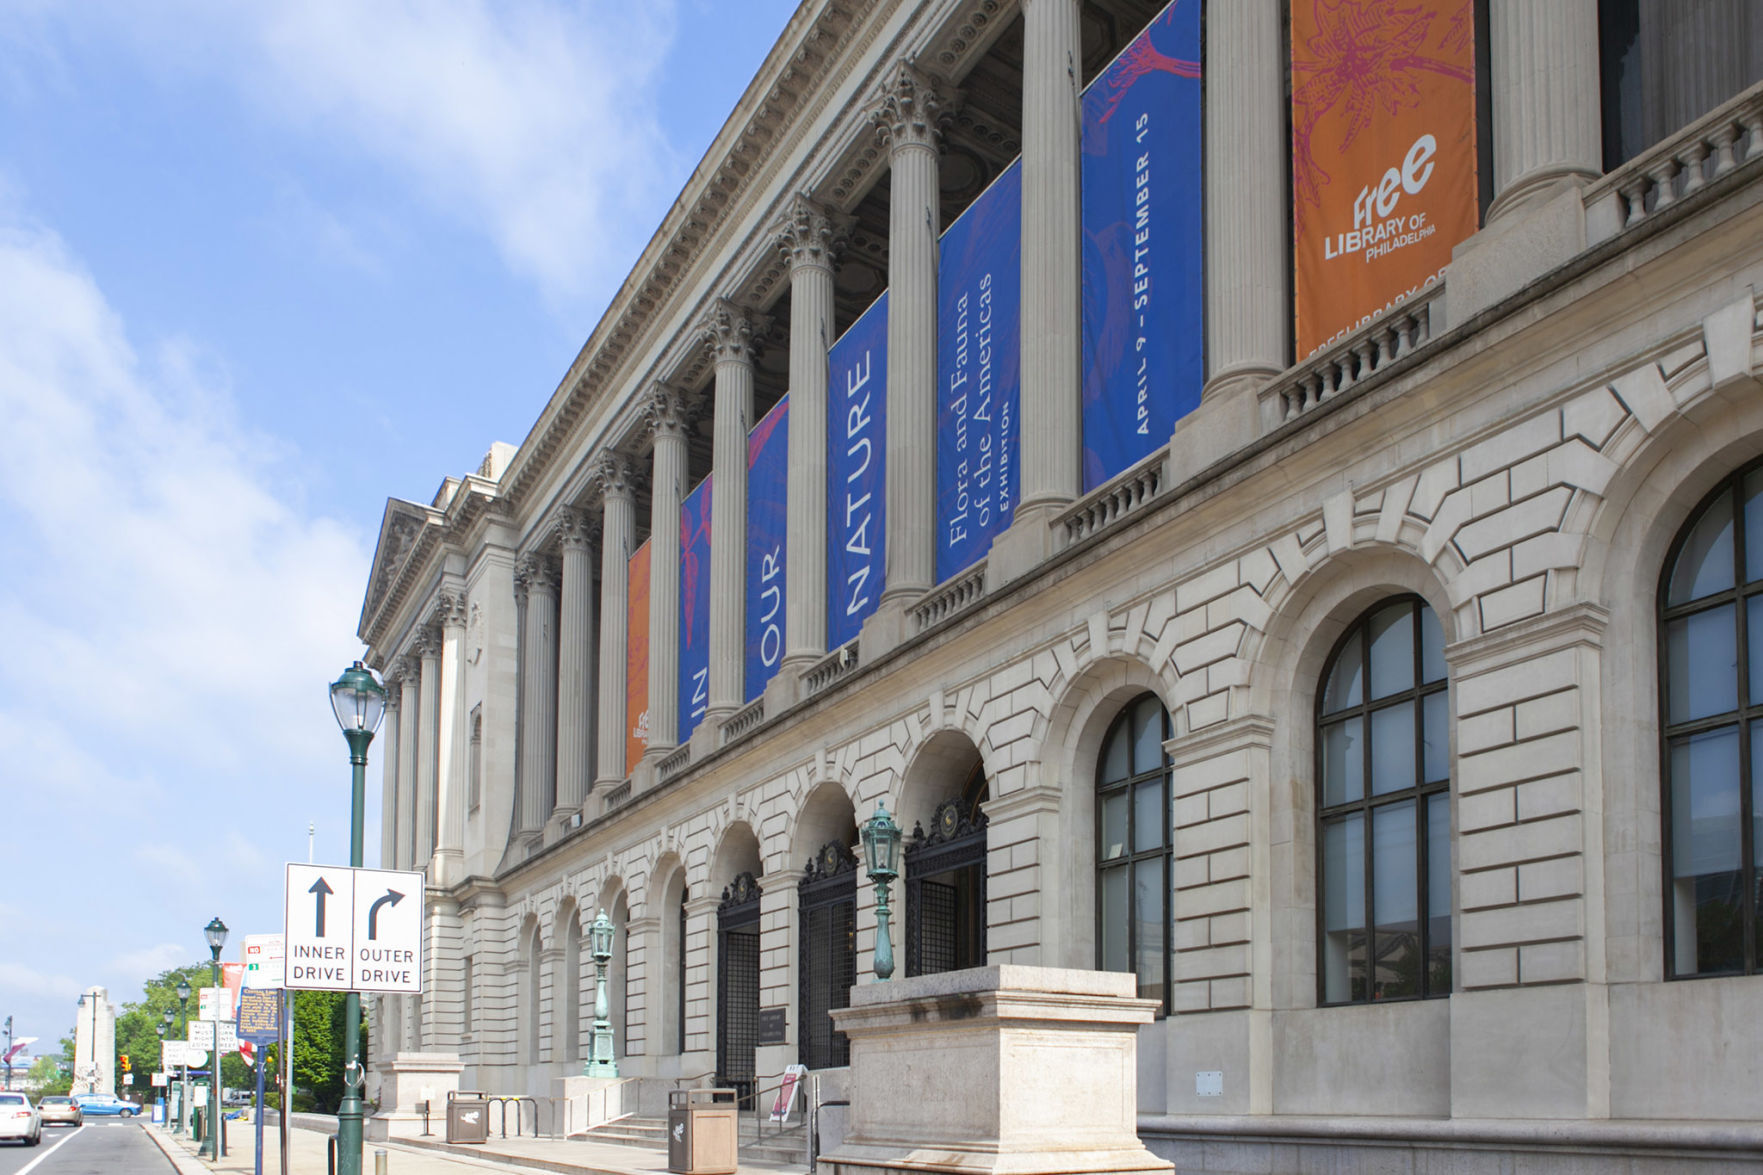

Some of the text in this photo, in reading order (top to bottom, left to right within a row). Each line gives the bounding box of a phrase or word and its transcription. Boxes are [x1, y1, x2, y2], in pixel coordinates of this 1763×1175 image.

[1136, 112, 1149, 144] 15
[1134, 152, 1150, 311] SEPTEMBER
[1324, 212, 1427, 260] LIBRARY OF
[1365, 223, 1436, 264] PHILADELPHIA
[1136, 336, 1146, 352] 9
[949, 291, 969, 549] Flora and Fauna
[973, 273, 992, 527] of the Americas
[1136, 356, 1150, 435] APRIL
[1000, 401, 1010, 512] EXHIBITION
[847, 350, 872, 616] NATURE
[761, 544, 780, 667] OUR
[691, 666, 707, 718] IN
[293, 965, 345, 981] DRIVE
[294, 945, 345, 960] INNER
[360, 948, 414, 963] OUTER
[362, 969, 411, 983] DRIVE
